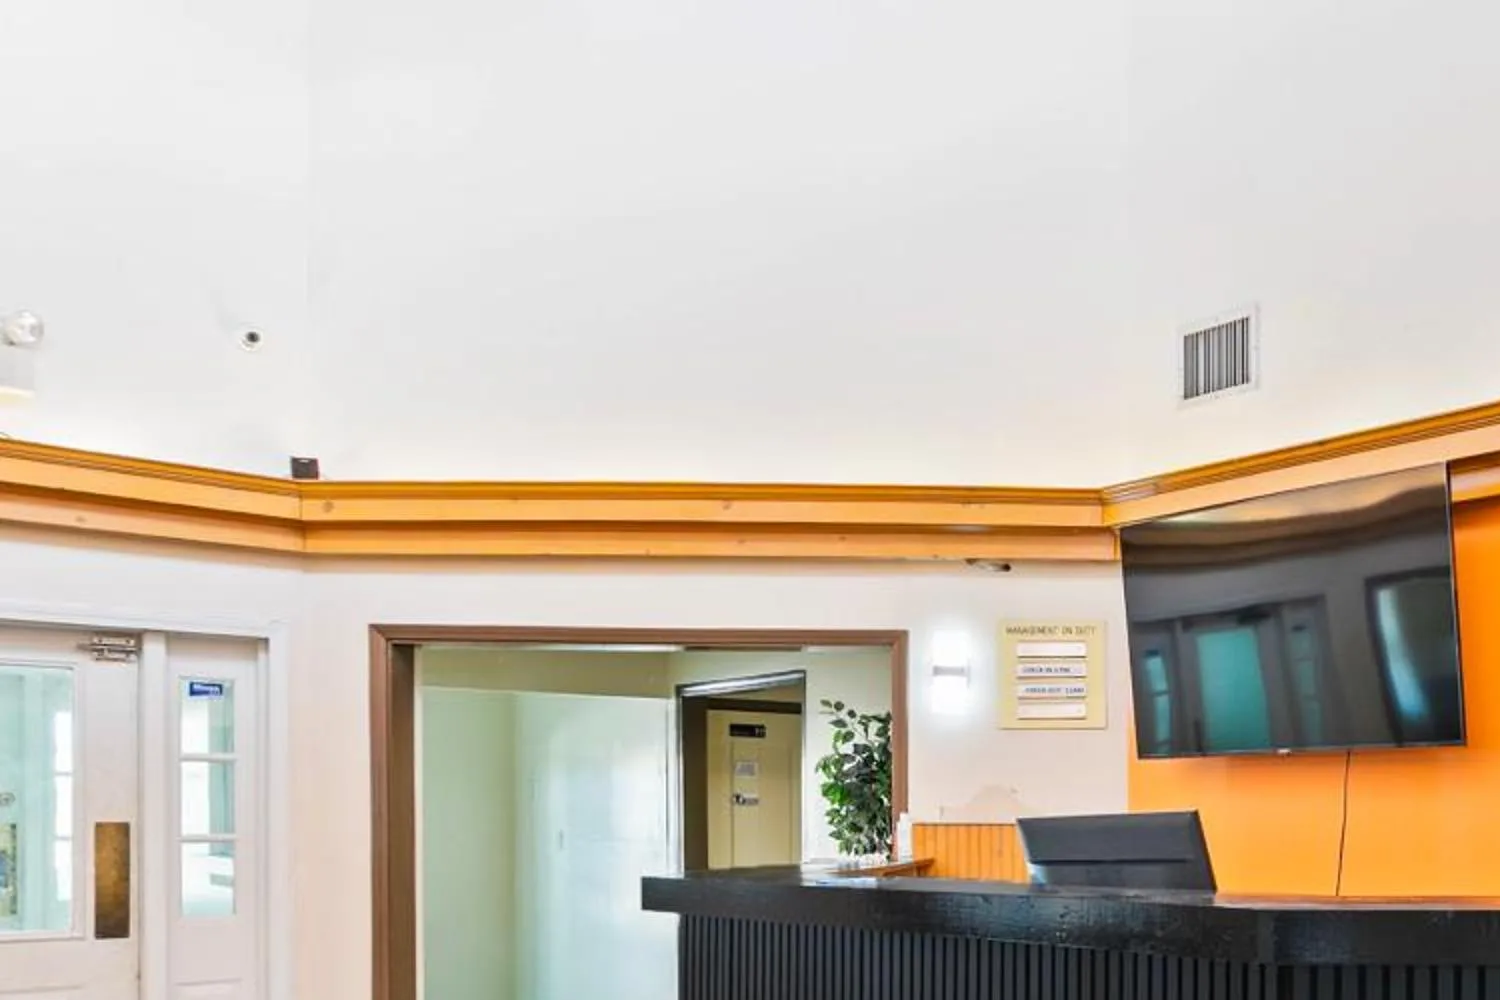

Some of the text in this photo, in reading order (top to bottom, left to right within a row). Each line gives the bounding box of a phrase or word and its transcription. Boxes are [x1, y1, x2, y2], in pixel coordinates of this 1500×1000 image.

[1005, 625, 1096, 636] MANAGEMENT ON DUTY
